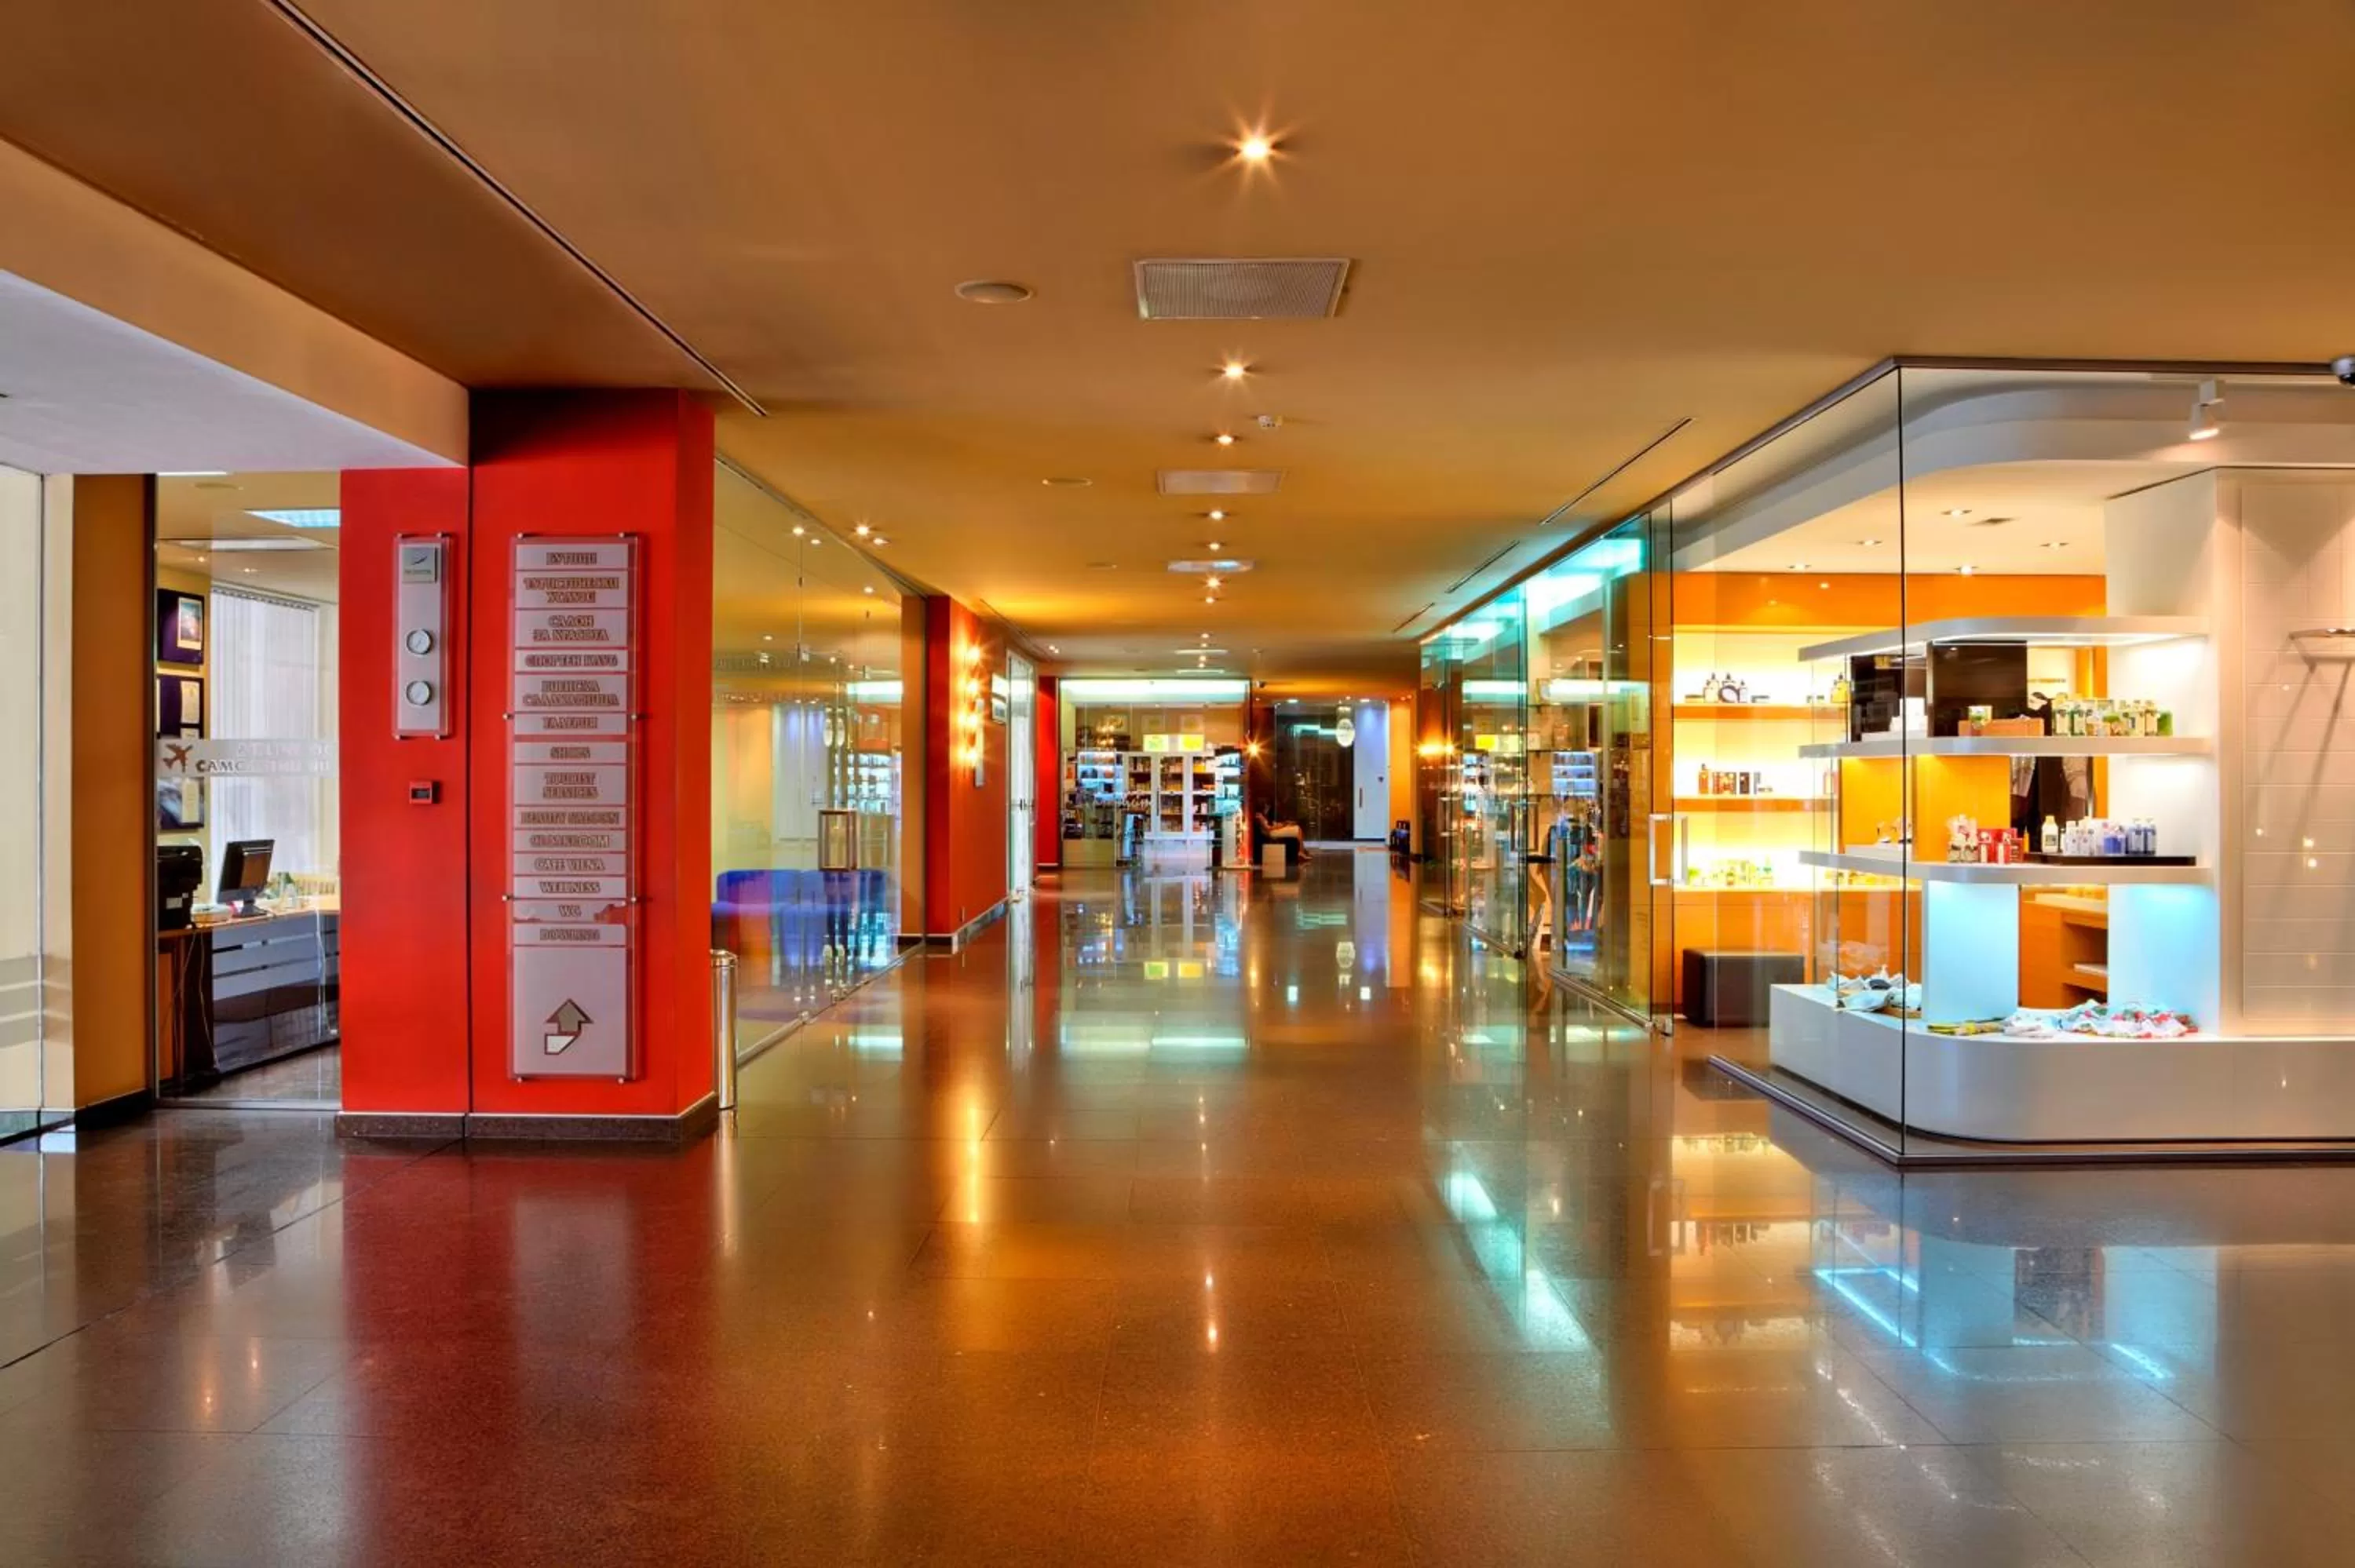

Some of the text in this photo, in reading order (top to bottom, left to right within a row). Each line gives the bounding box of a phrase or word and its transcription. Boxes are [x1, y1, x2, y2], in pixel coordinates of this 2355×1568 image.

[549, 614, 594, 629] САЛОН
[525, 653, 581, 667] СПОРТЕН
[544, 771, 597, 785] TOURIST
[542, 786, 599, 799] SERVICES
[534, 856, 565, 871] CAFE
[539, 881, 601, 893] WELLNESS
[558, 904, 582, 917] WC
[539, 928, 601, 942] BOWLING
